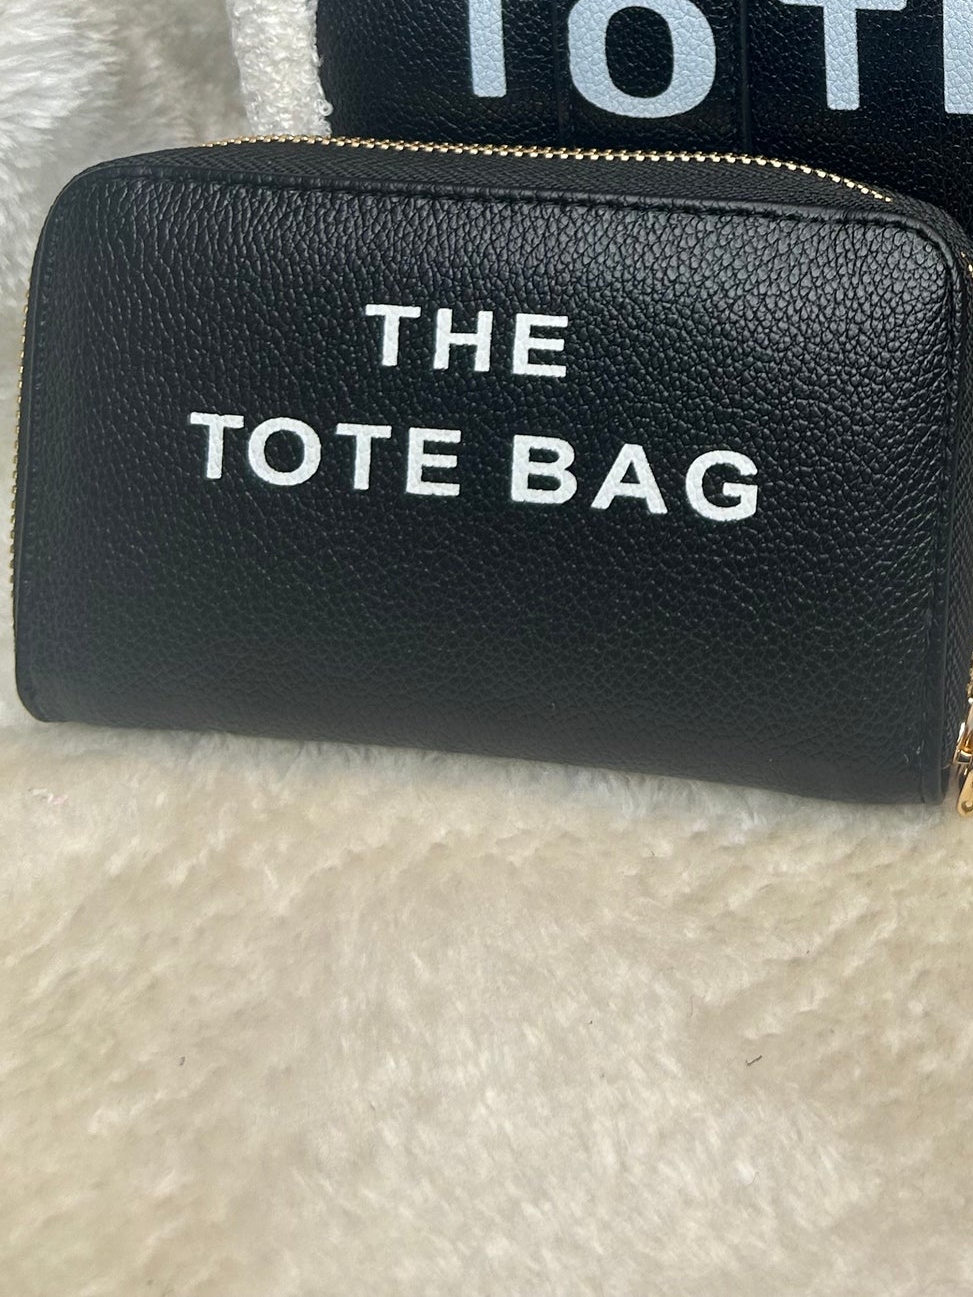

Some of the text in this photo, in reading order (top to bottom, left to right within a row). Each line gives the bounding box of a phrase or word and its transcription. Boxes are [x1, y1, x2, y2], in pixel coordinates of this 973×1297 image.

[363, 302, 570, 379] THE
[188, 410, 759, 524] TOTE BAG
